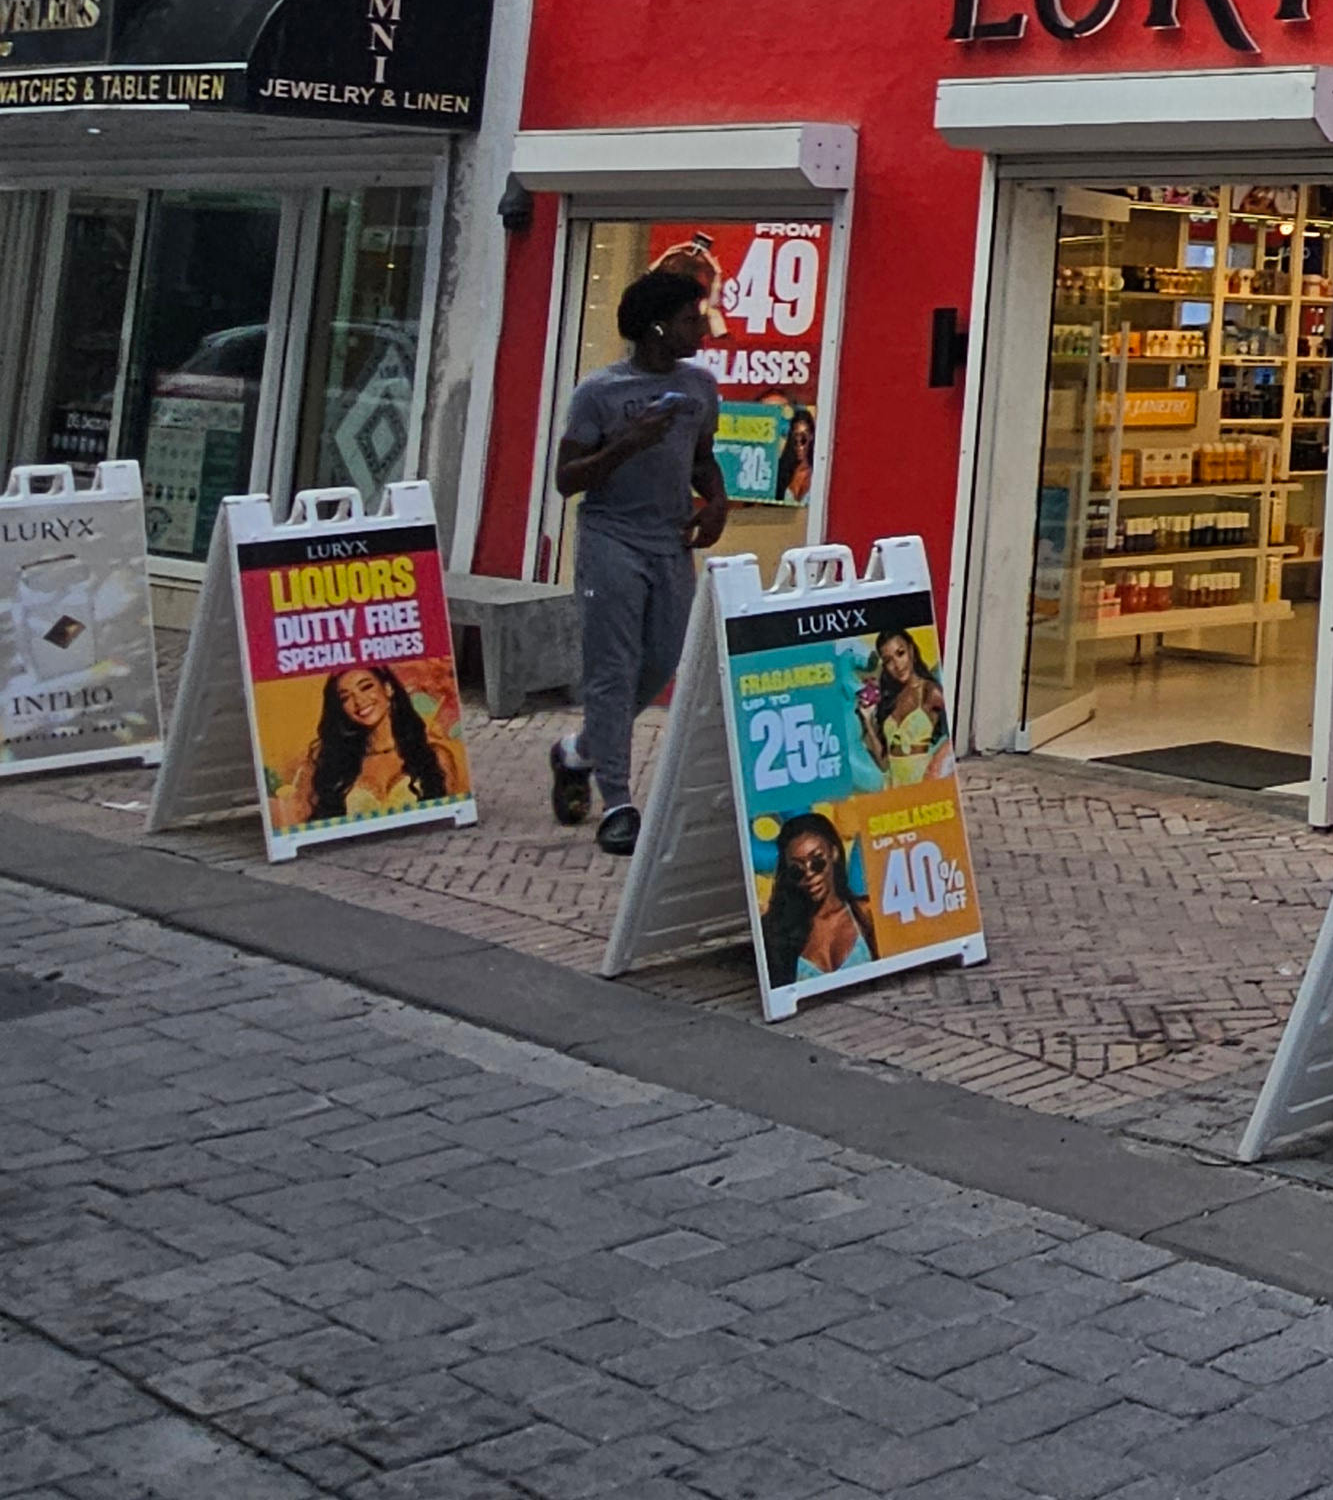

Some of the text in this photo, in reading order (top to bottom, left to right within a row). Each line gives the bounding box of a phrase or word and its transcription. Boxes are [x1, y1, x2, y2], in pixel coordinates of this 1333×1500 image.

[83, 77, 94, 100] &
[102, 74, 160, 100] TABLE
[167, 74, 225, 100] LINEN
[259, 79, 470, 113] JEWELRY & LINEN
[755, 223, 821, 238] FROM
[722, 237, 820, 336] $49
[3, 517, 94, 542] LURYX
[307, 540, 369, 560] LURYX
[269, 555, 417, 614] LIQUORS
[274, 599, 421, 648] DUTTY FREE
[797, 608, 868, 636] LURYX
[277, 631, 424, 675] SPECIAL PRICES
[742, 694, 791, 711] UP TO
[872, 831, 917, 851] UP TO
